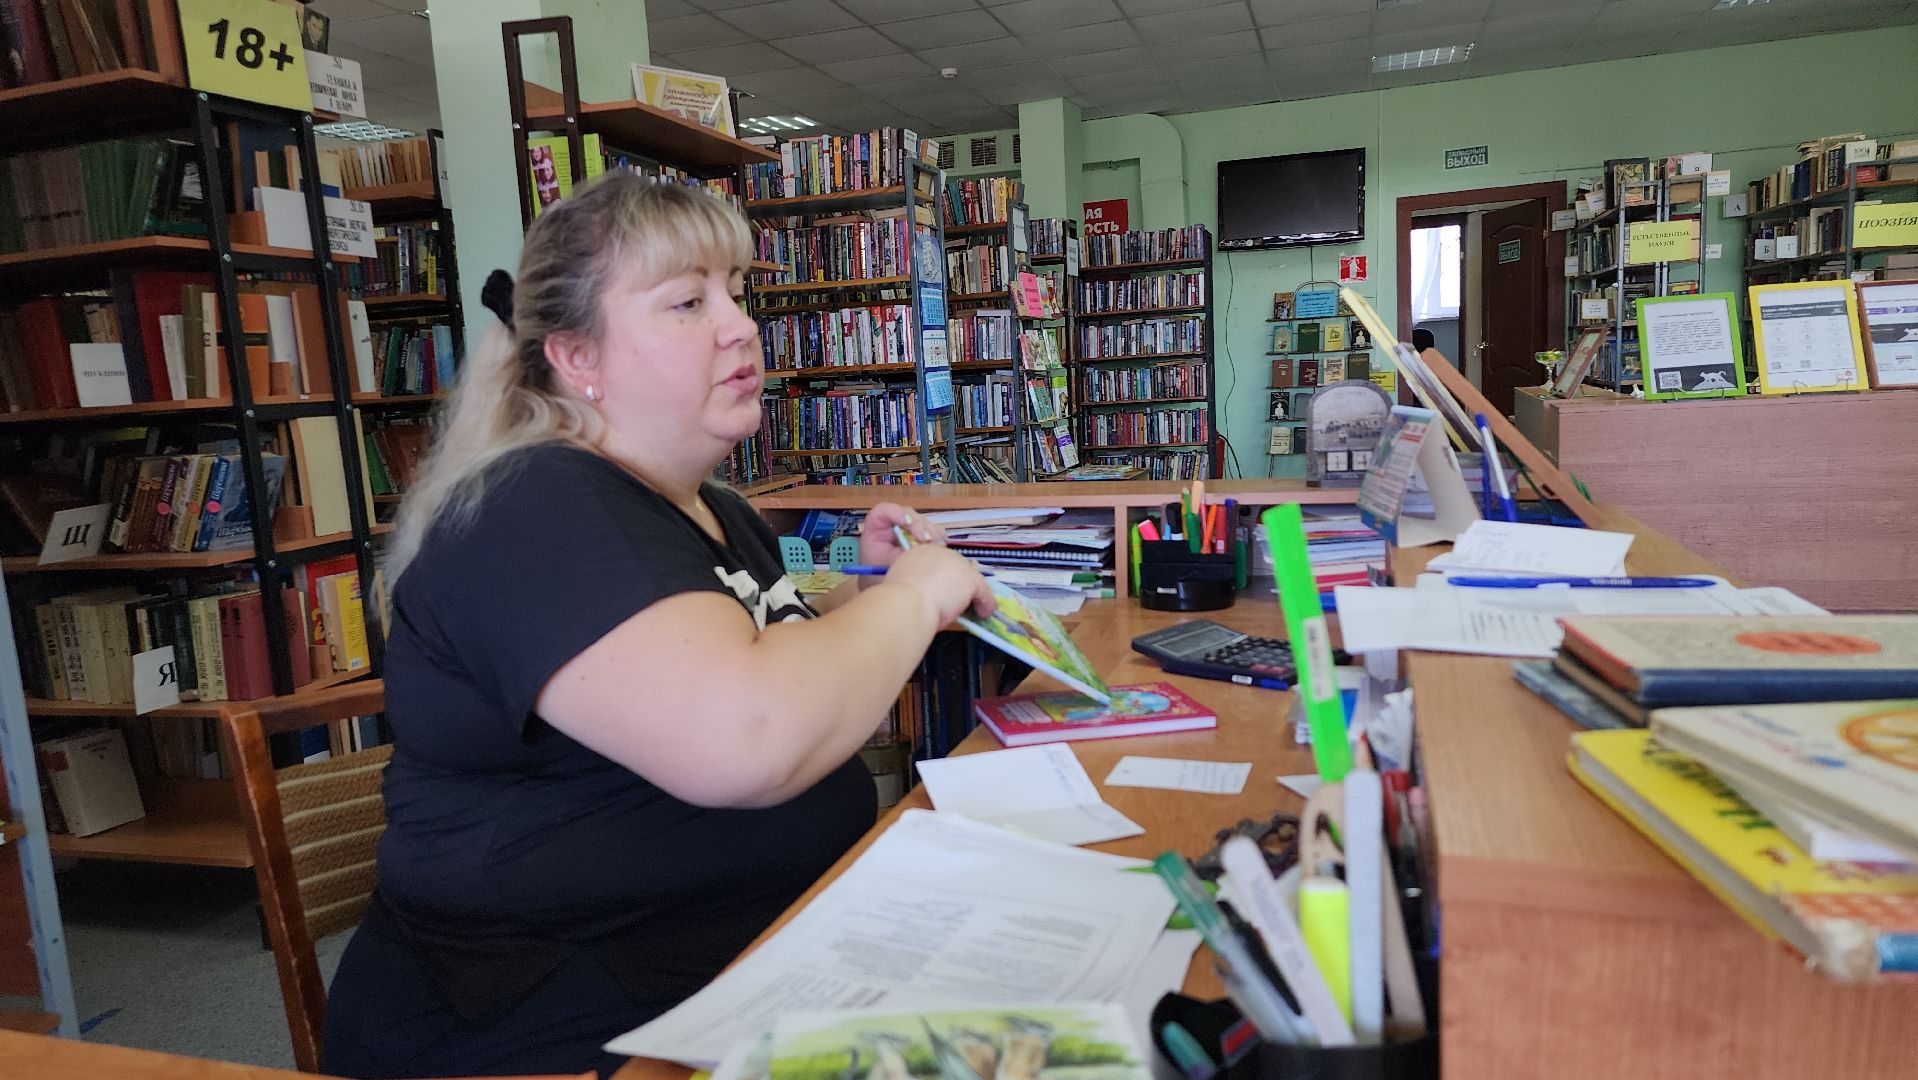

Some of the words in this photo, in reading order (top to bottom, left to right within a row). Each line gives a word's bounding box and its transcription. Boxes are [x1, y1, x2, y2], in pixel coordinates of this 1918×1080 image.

[208, 18, 295, 71] 18+
[1447, 146, 1485, 158] ЗАПАСНЫЙ
[1447, 154, 1486, 168] ВЫХОД
[1085, 207, 1103, 220] АЯ
[1734, 203, 1741, 211] А
[1858, 216, 1918, 229] ПОЭЗИЯ
[1632, 230, 1691, 241] ЕСТЕСТВЕННЫЕ
[1648, 239, 1675, 248] НАУКИ
[1763, 245, 1770, 254] Б
[61, 523, 92, 547] Щ
[158, 661, 177, 687] Я
